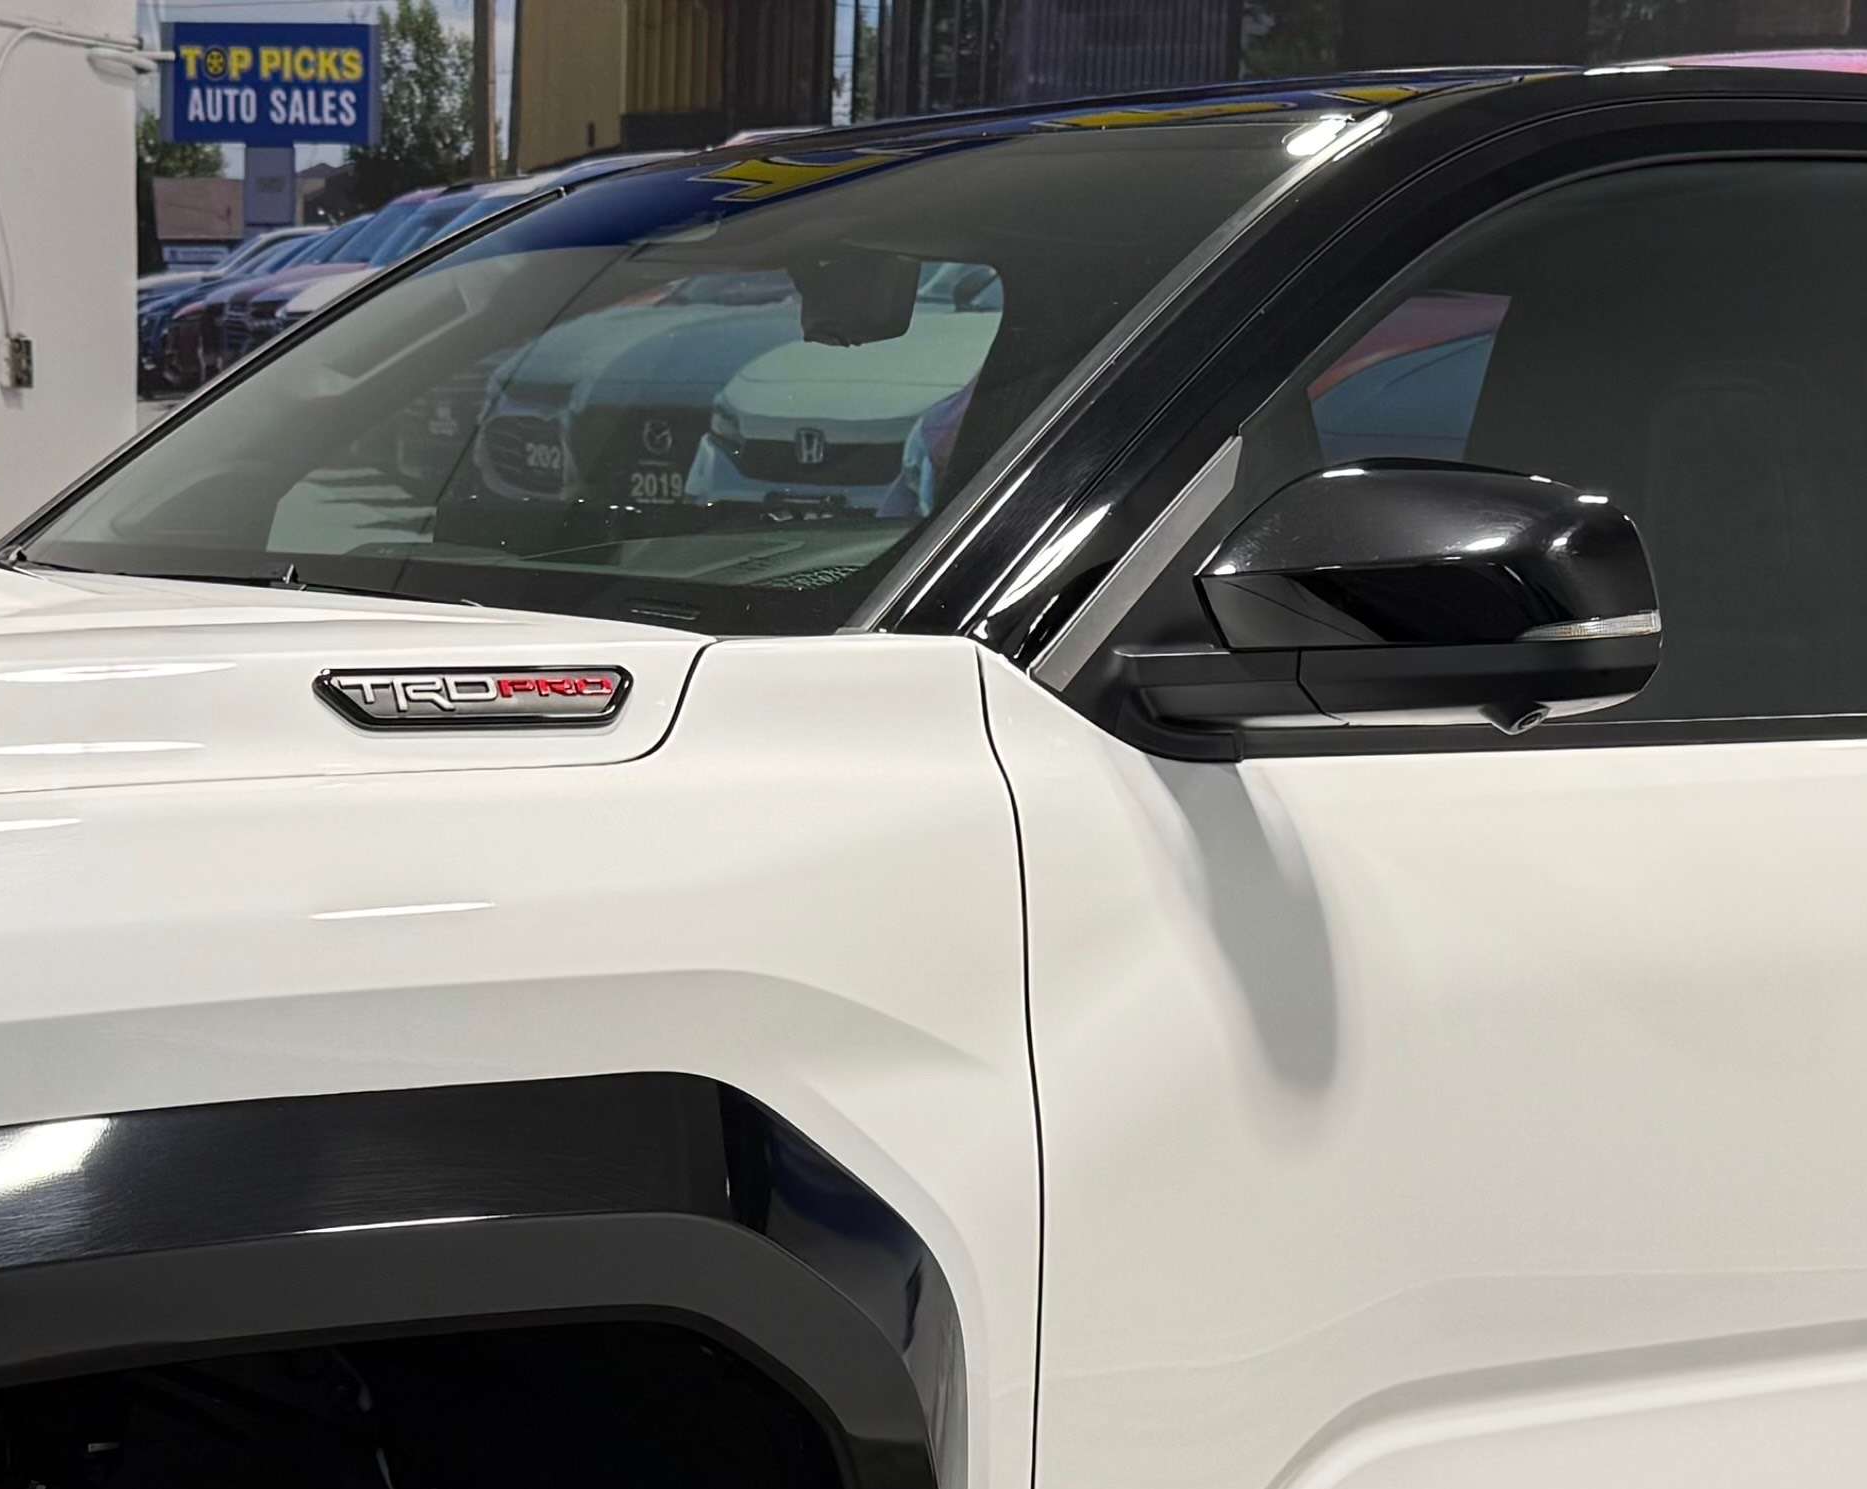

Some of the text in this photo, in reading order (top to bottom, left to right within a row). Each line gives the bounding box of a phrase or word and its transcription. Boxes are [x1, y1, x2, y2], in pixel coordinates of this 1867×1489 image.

[180, 46, 364, 82] TOP PICKS
[188, 86, 357, 127] AUTO SALES
[632, 472, 683, 498] 2019
[331, 675, 498, 713] TRD
